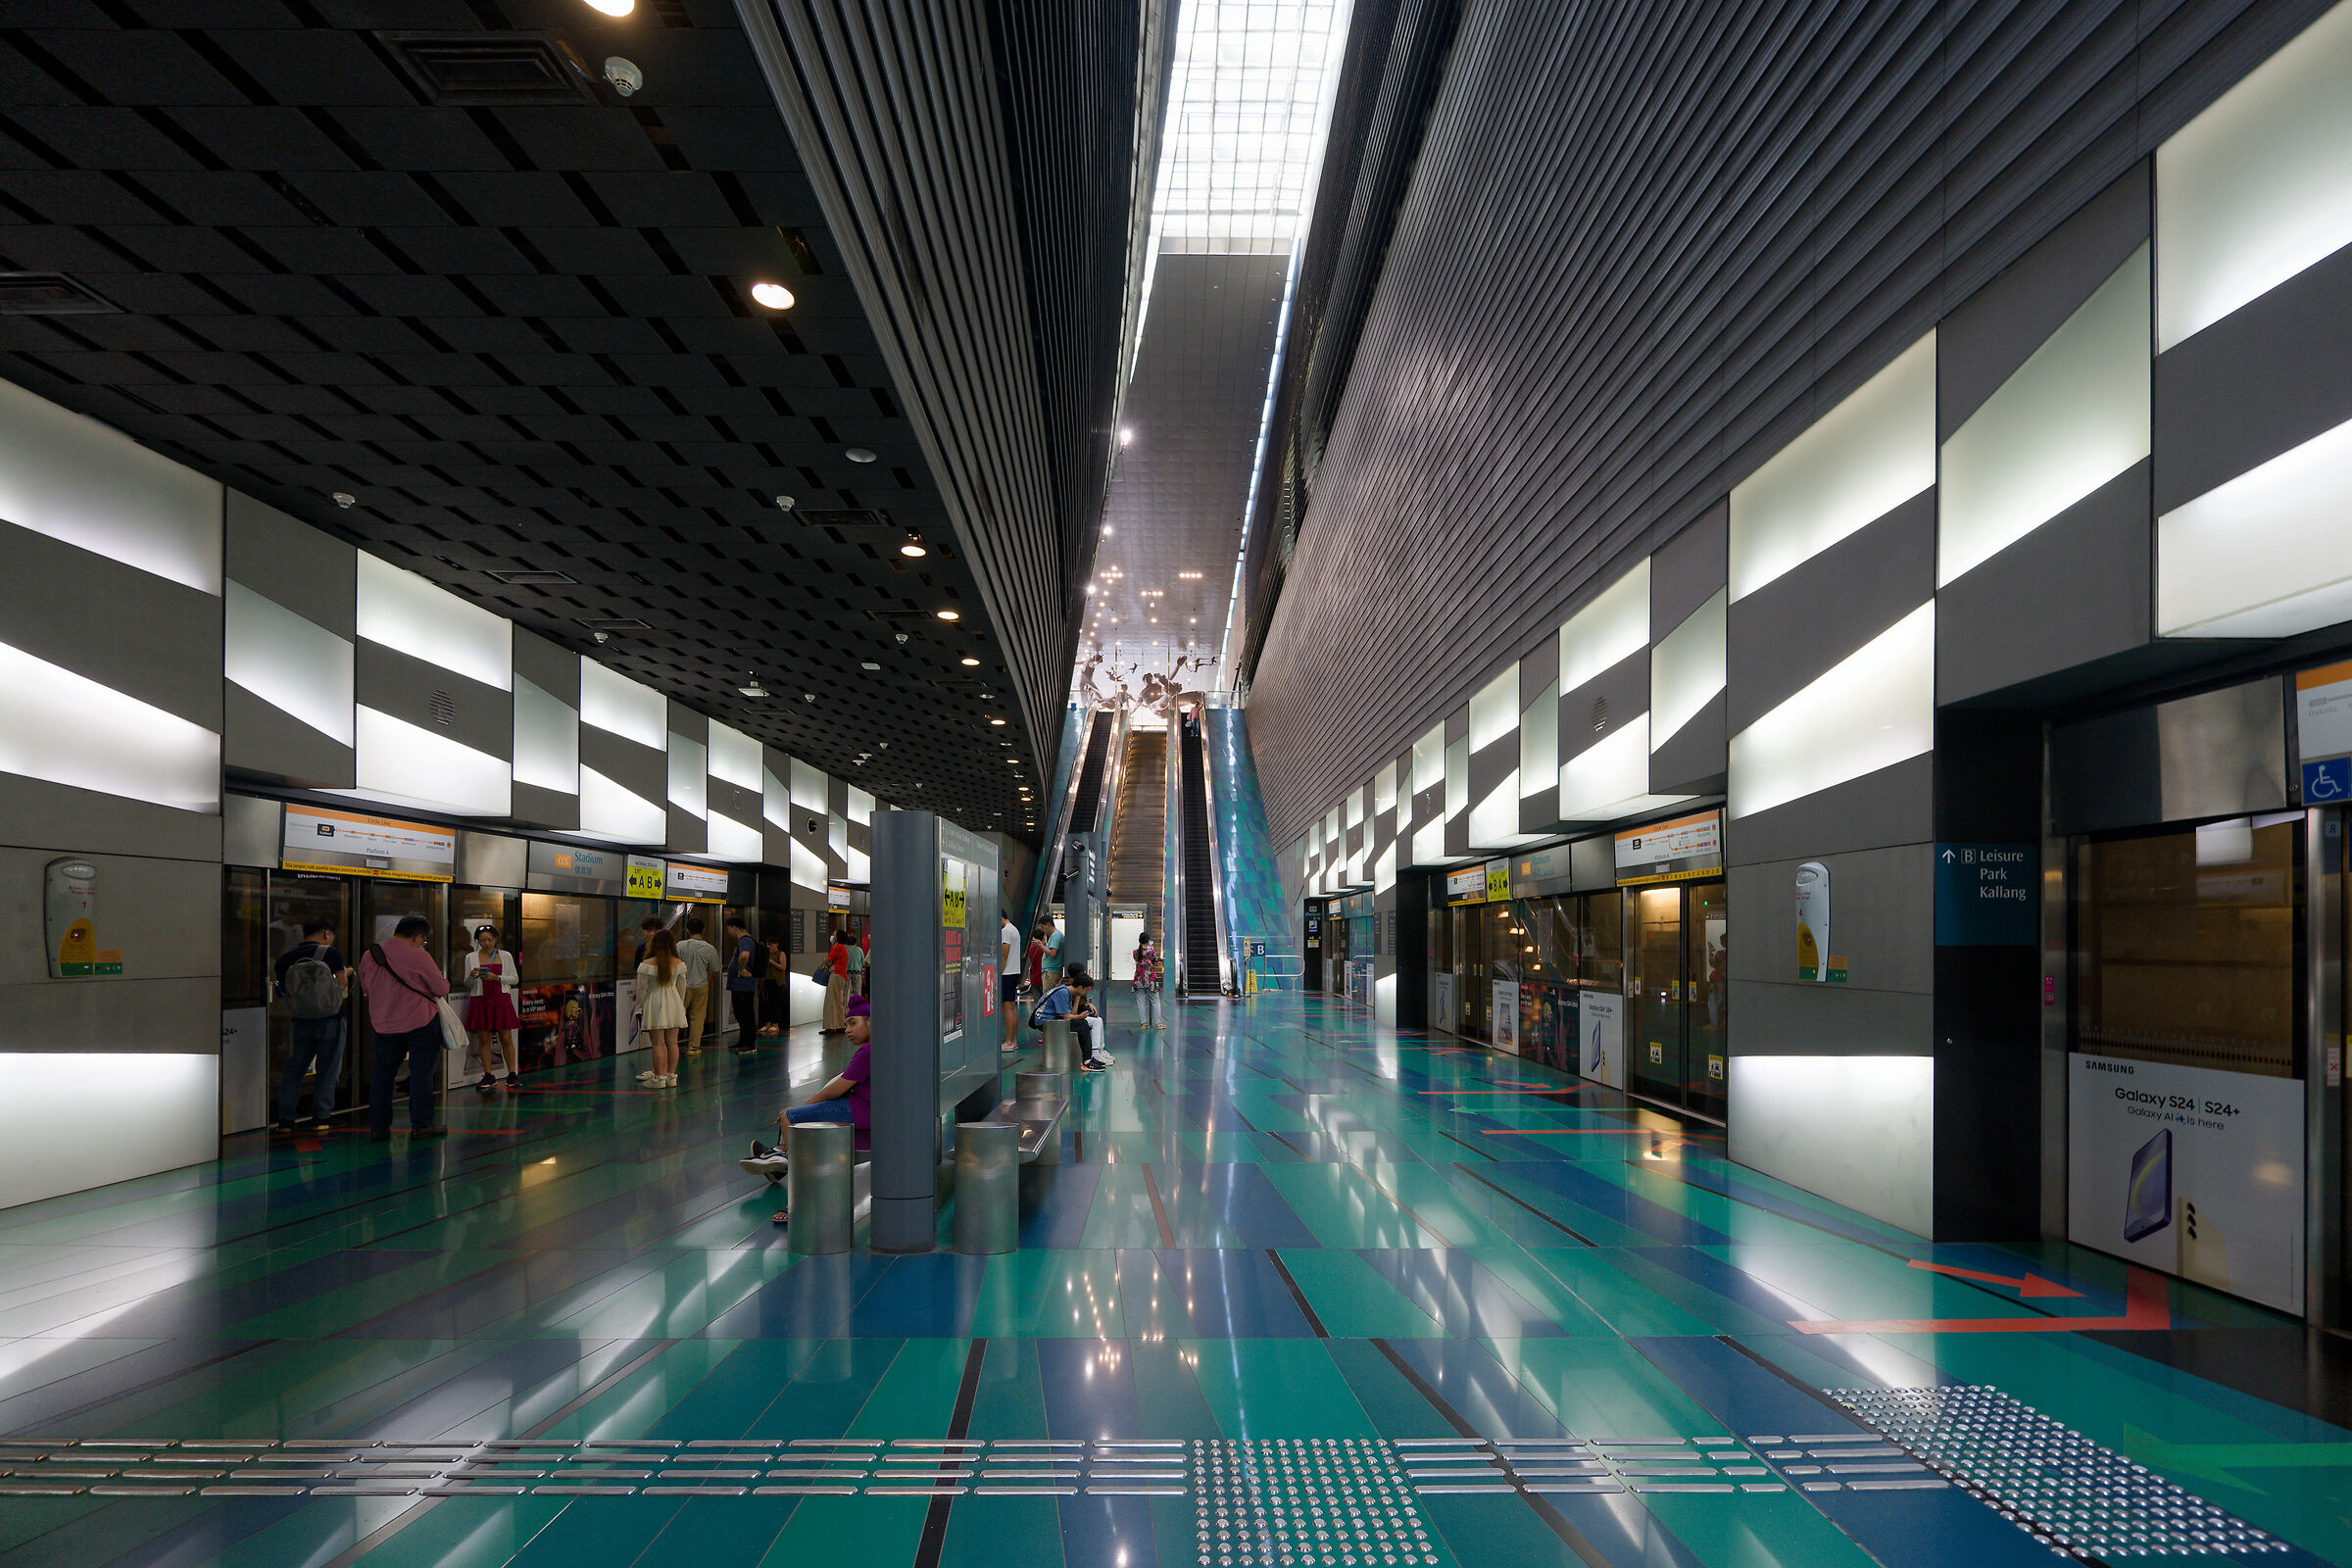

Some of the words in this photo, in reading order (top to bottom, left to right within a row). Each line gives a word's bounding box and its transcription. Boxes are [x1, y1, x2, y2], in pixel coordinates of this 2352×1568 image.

[2308, 706, 2337, 717] Dakota
[575, 852, 604, 864] Stadium
[1980, 849, 2024, 862] Leisure
[1980, 867, 2008, 880] Park
[638, 875, 645, 888] A
[647, 876, 653, 889] B
[1980, 885, 2027, 901] Kallang
[1257, 945, 1265, 955] B
[2085, 1060, 2134, 1075] SAMSUNG
[2115, 1088, 2166, 1108] Galaxy
[2169, 1096, 2195, 1111] S24
[2204, 1101, 2240, 1116] S24+
[2127, 1105, 2162, 1121] Galaxy
[2164, 1112, 2174, 1121] AI
[2186, 1115, 2195, 1126] is
[2197, 1117, 2225, 1131] here
